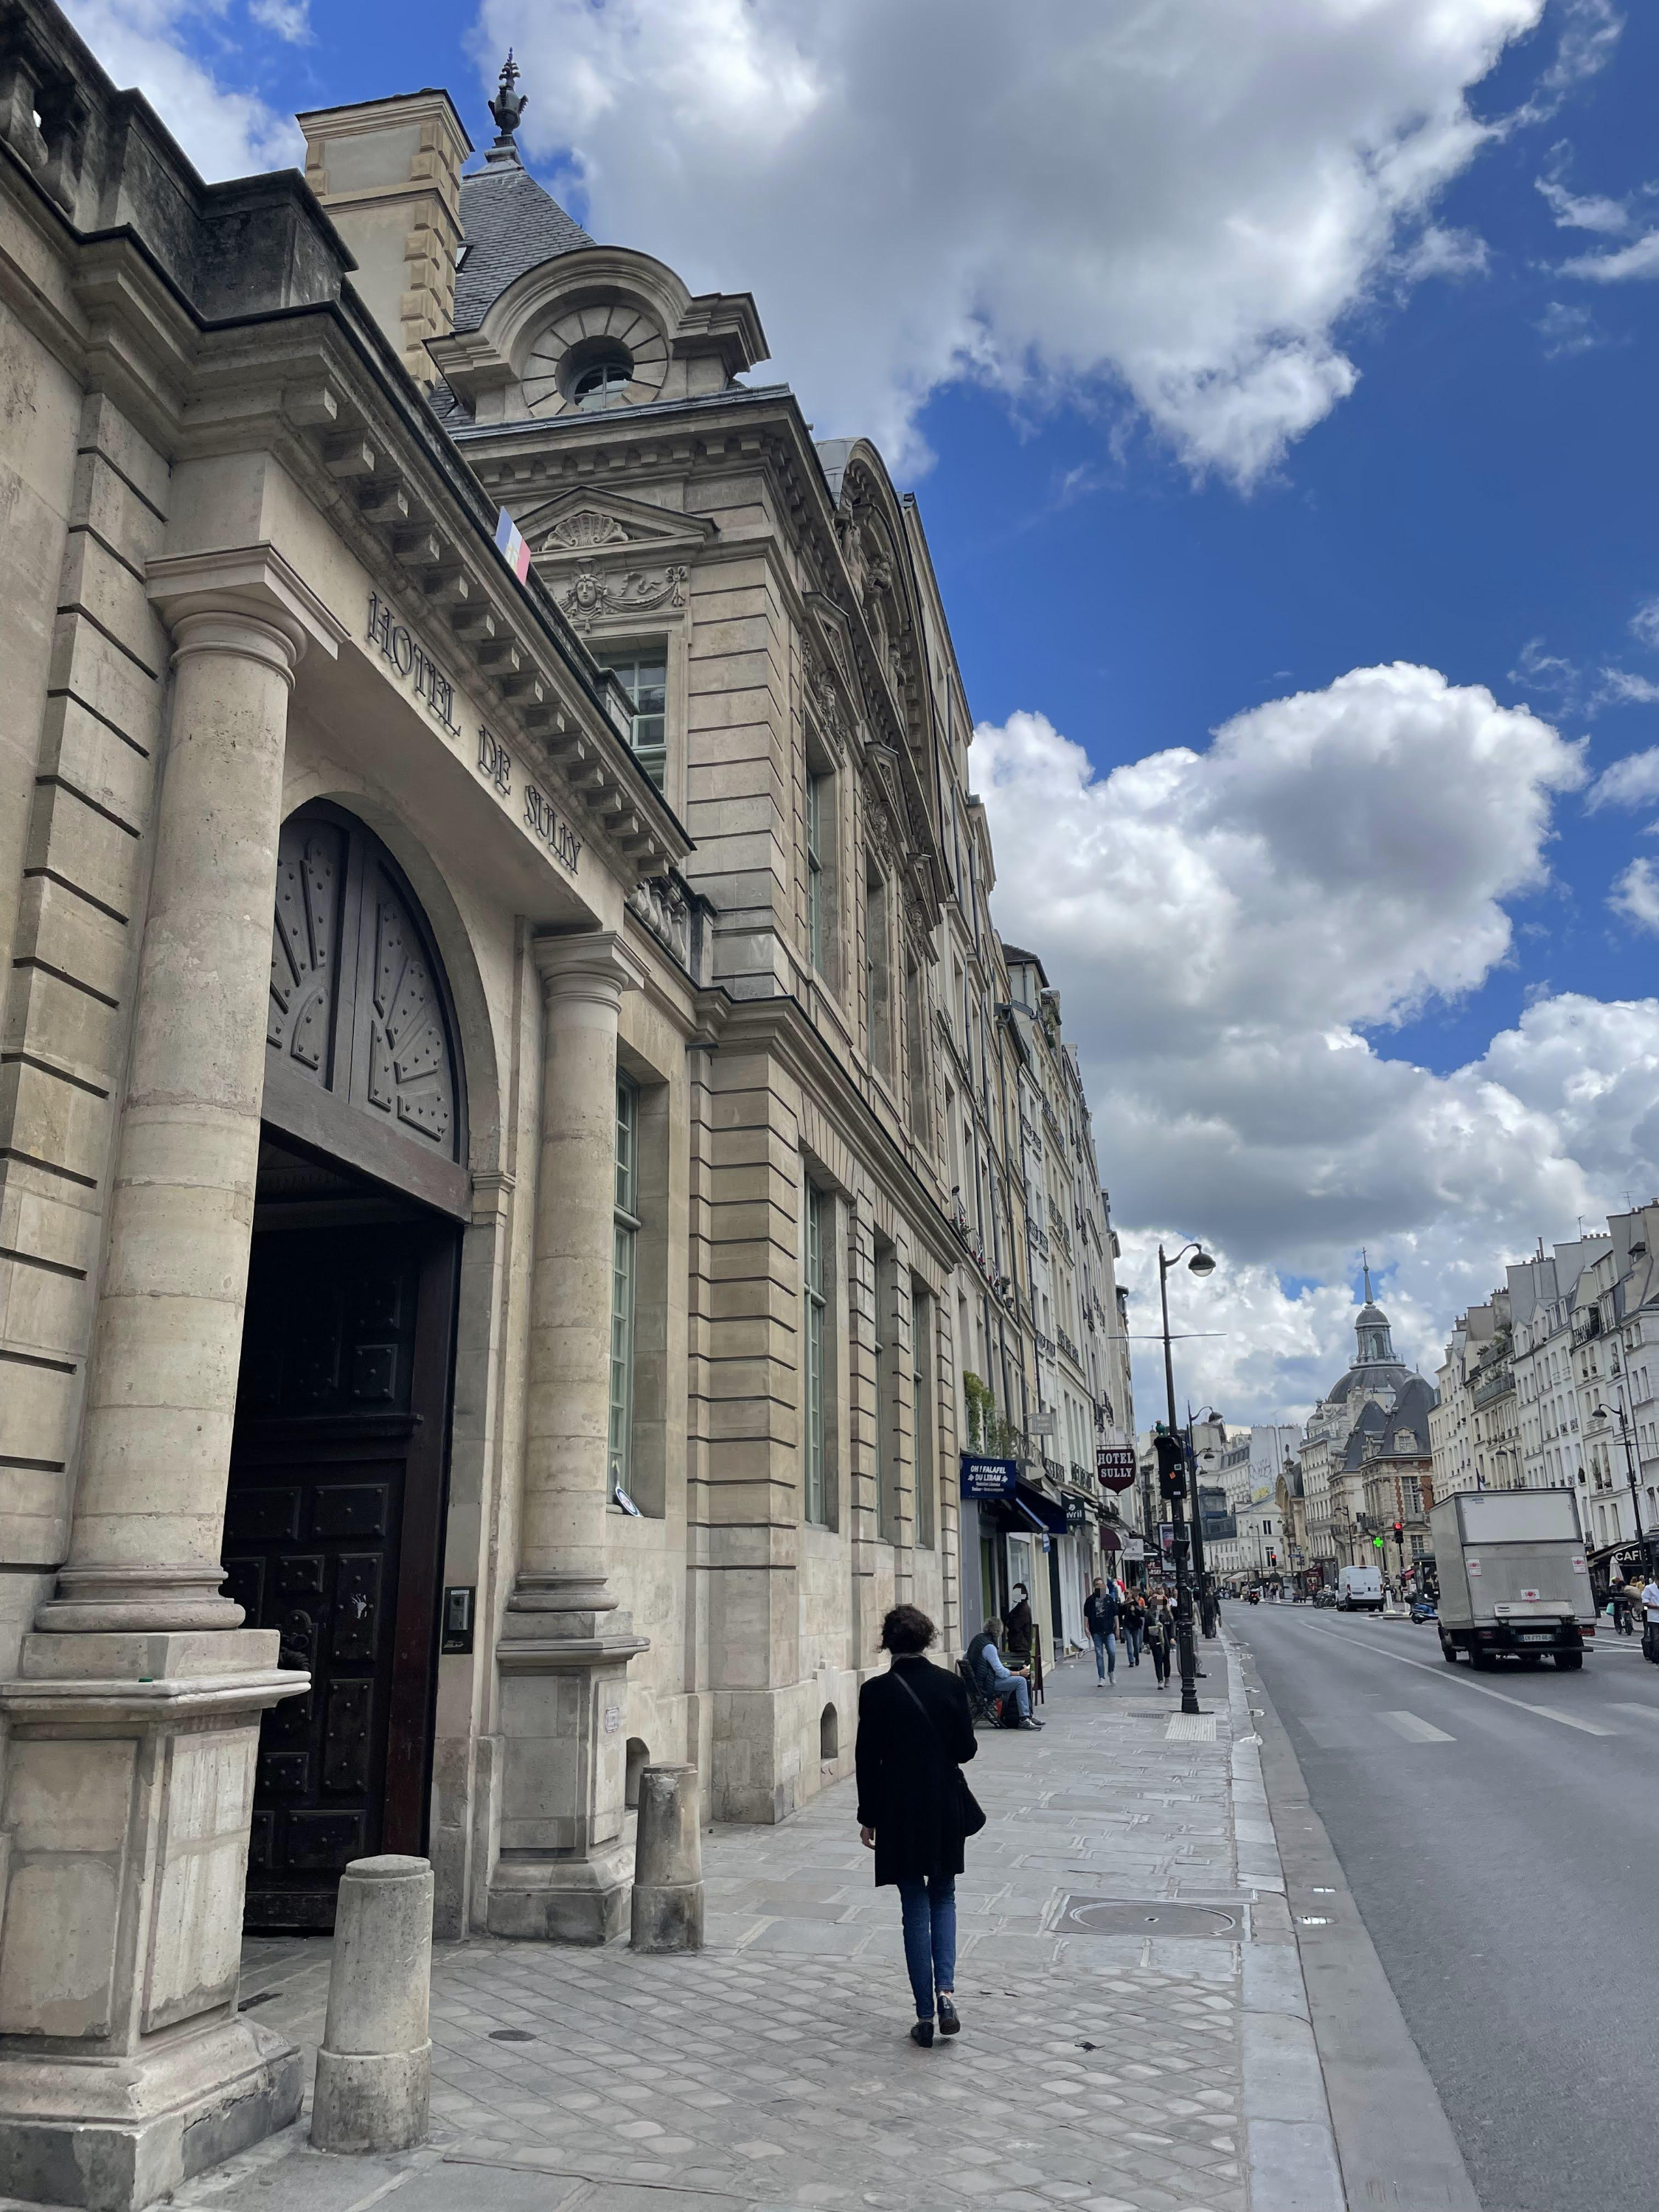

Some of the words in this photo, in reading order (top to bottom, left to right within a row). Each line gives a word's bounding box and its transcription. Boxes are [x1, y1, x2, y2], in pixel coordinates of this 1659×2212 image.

[368, 591, 462, 737] HOTEL
[478, 724, 512, 796] DE
[524, 785, 582, 875] SULLY
[1098, 1453, 1134, 1464] HOTEL
[970, 1465, 979, 1473] OH
[982, 1466, 1006, 1474] FALAFEL
[1101, 1467, 1133, 1478] SULLY
